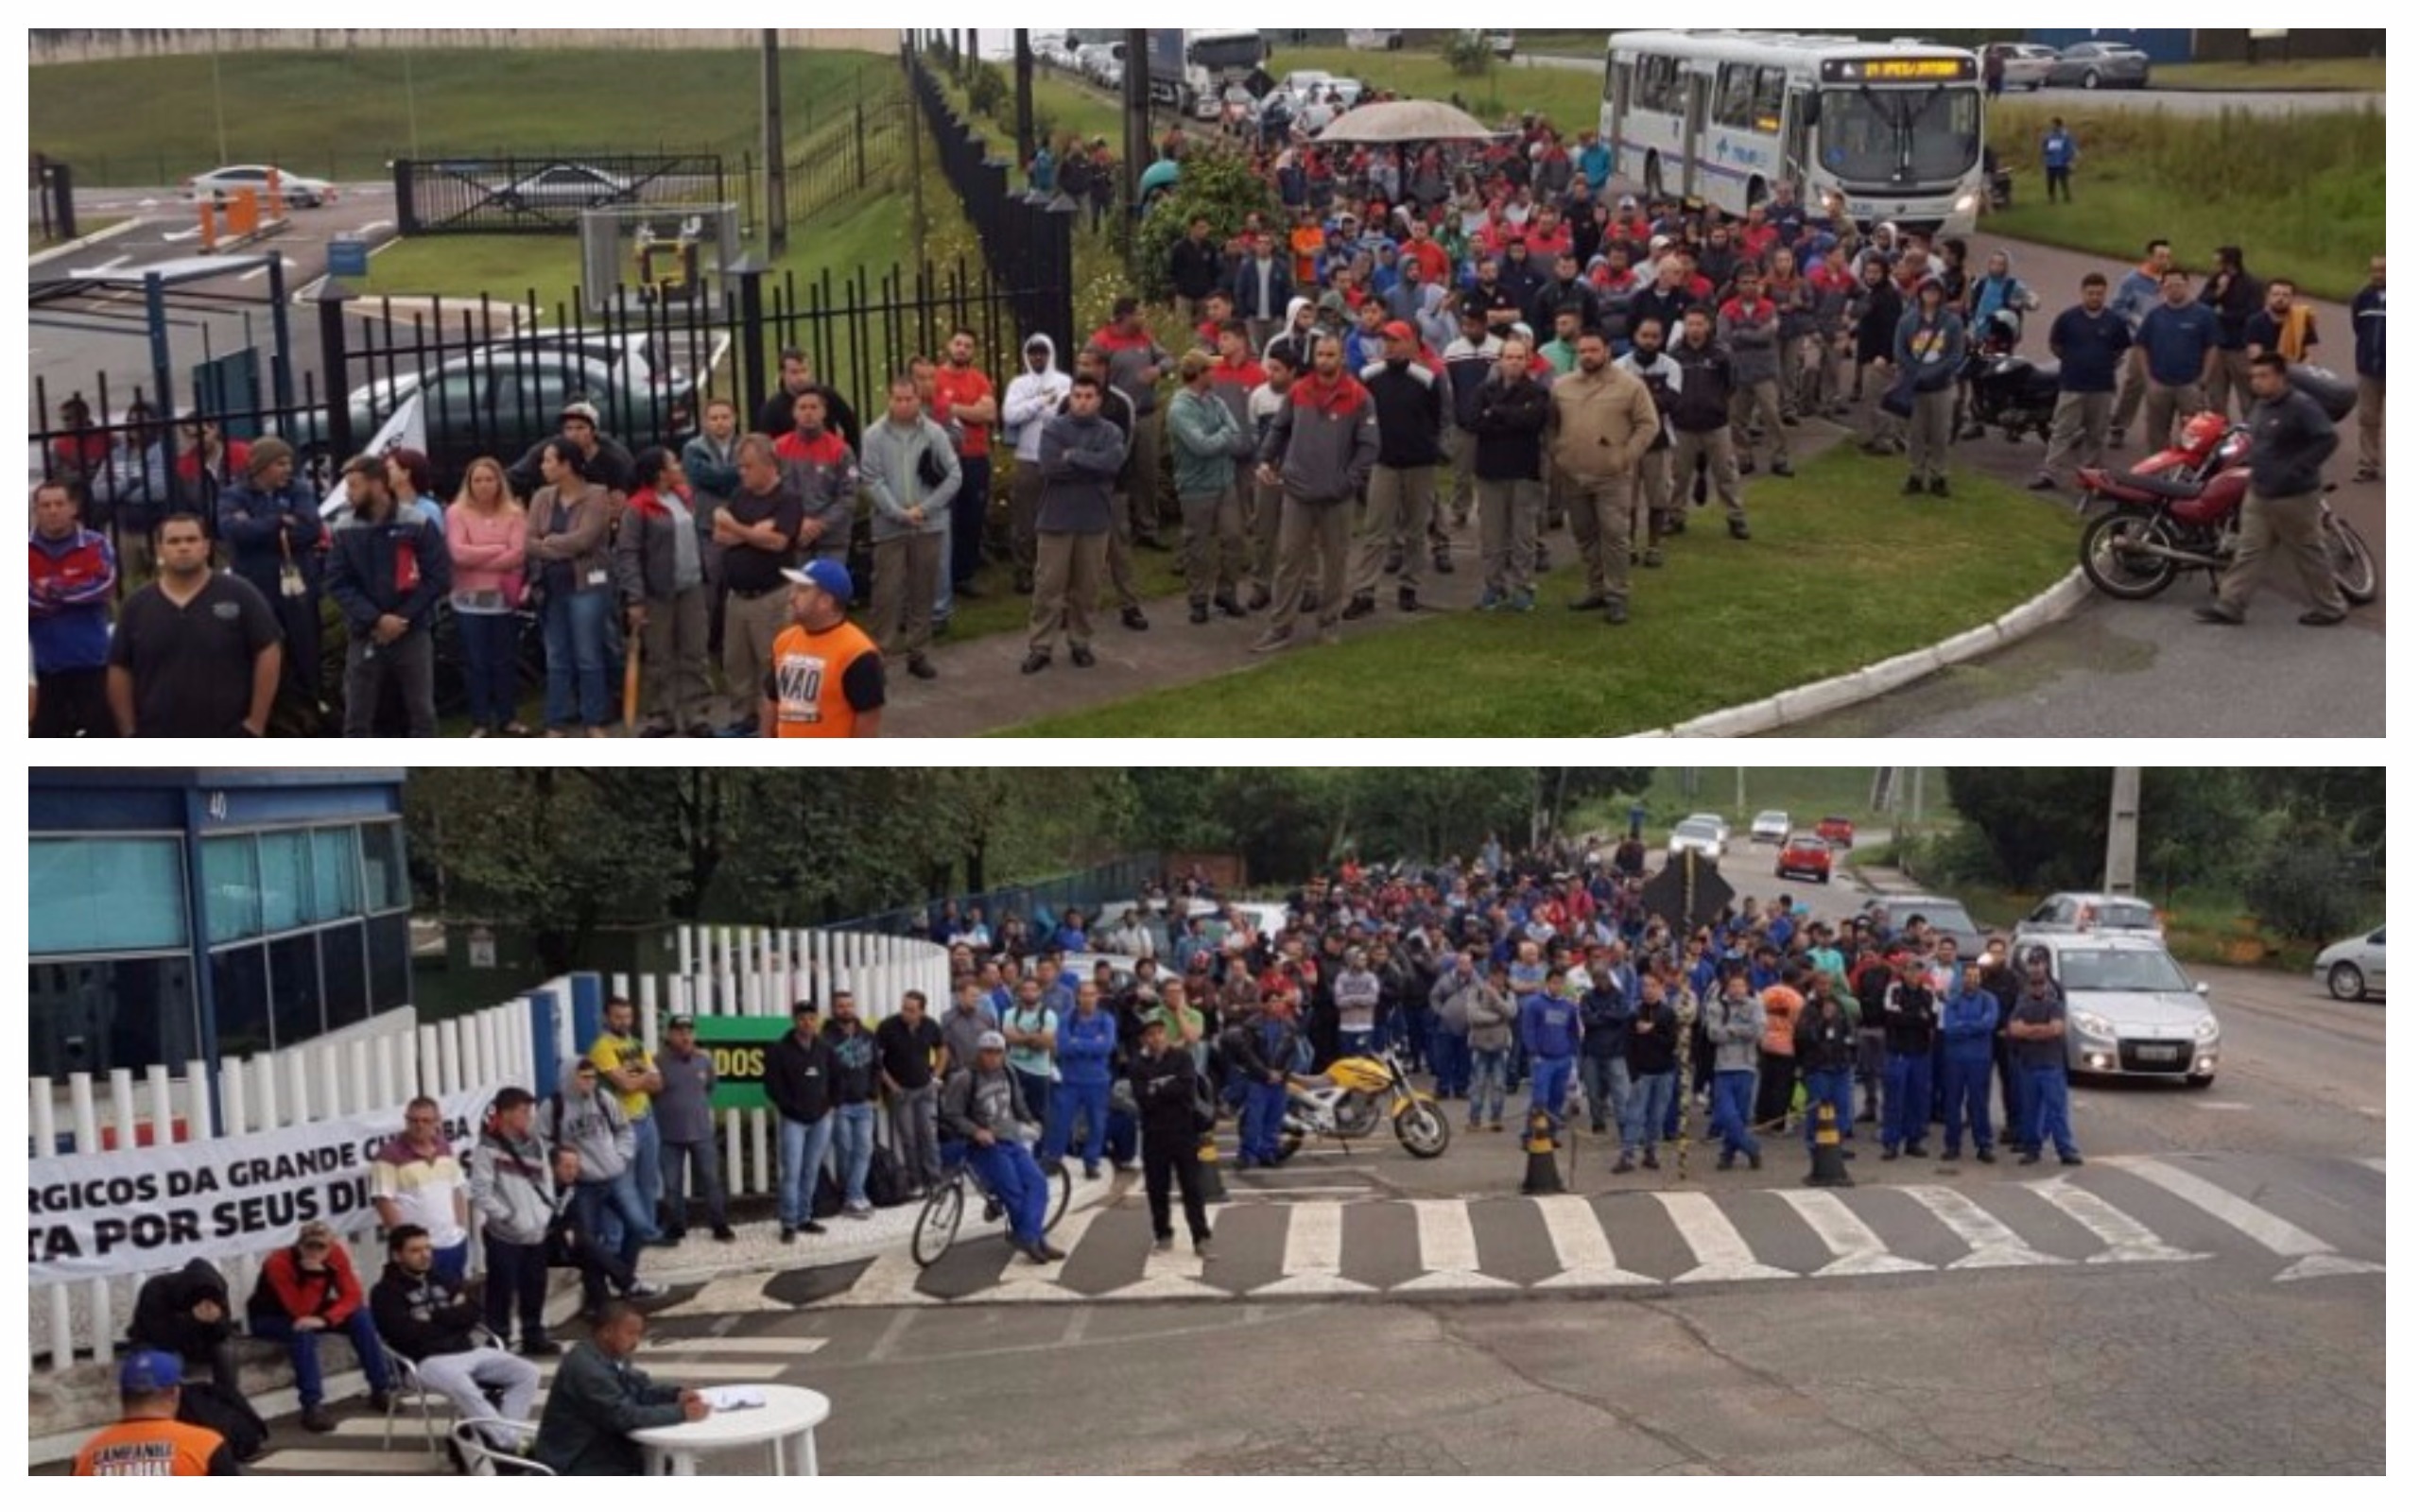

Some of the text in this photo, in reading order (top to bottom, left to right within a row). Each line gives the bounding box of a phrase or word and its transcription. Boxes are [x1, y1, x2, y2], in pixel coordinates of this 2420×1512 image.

[167, 1166, 219, 1197] DA
[227, 1142, 357, 1188] GRANDE
[94, 1209, 202, 1255] POR
[213, 1186, 319, 1238] SEUS
